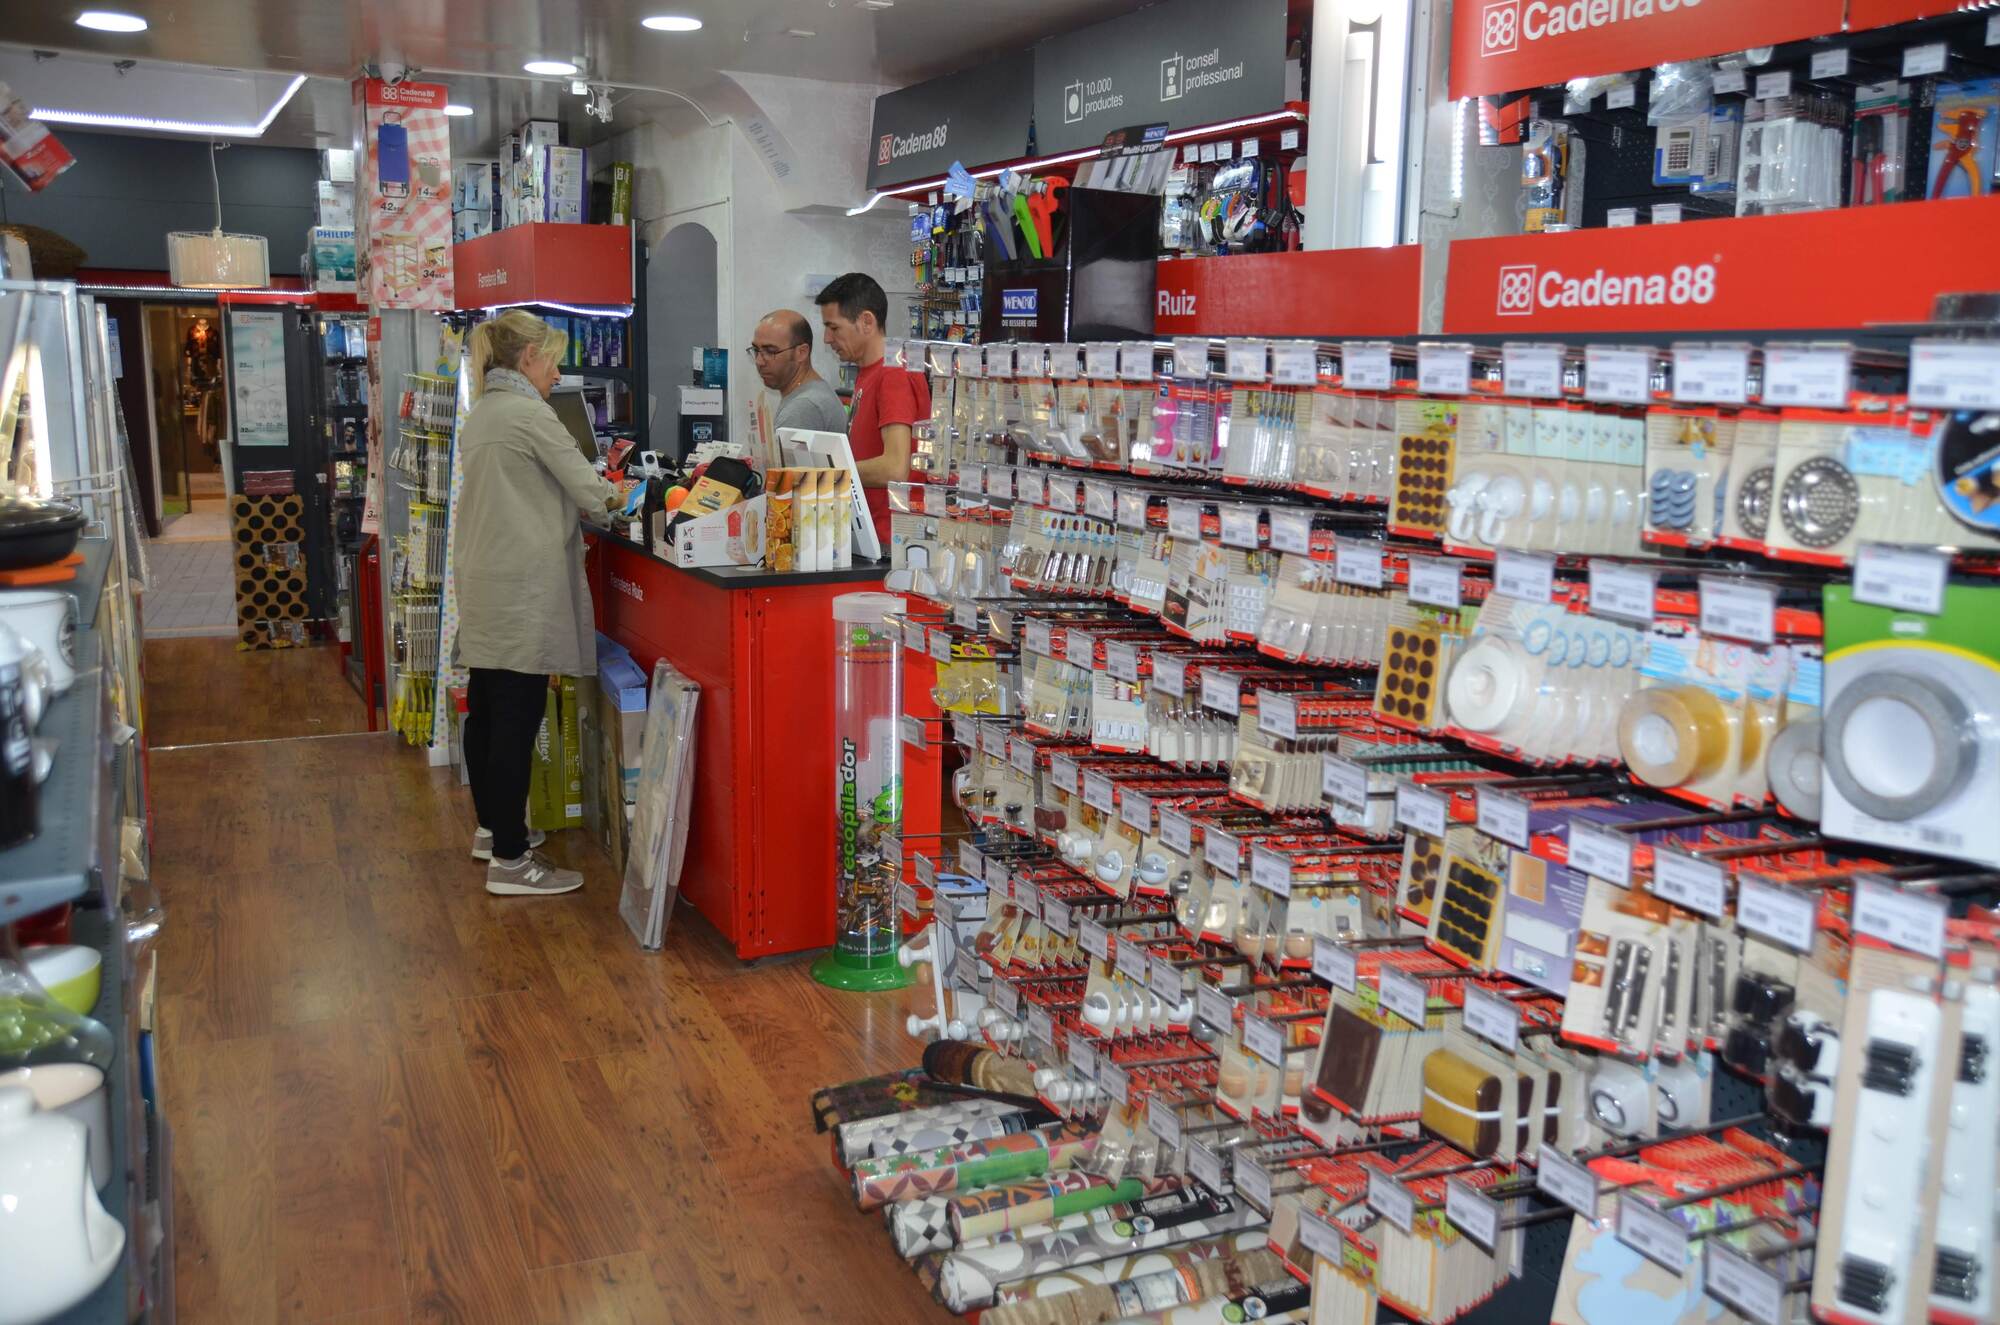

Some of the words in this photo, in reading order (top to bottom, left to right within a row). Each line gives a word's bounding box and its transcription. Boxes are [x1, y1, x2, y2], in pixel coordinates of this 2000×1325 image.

[1522, 0, 1702, 41] Cadena
[1186, 48, 1219, 71] consell
[1086, 78, 1112, 96] 10.000
[1185, 63, 1243, 93] professional
[1085, 94, 1124, 117] productes
[1158, 288, 1196, 317] Ruiz
[842, 737, 860, 881] recopilador
